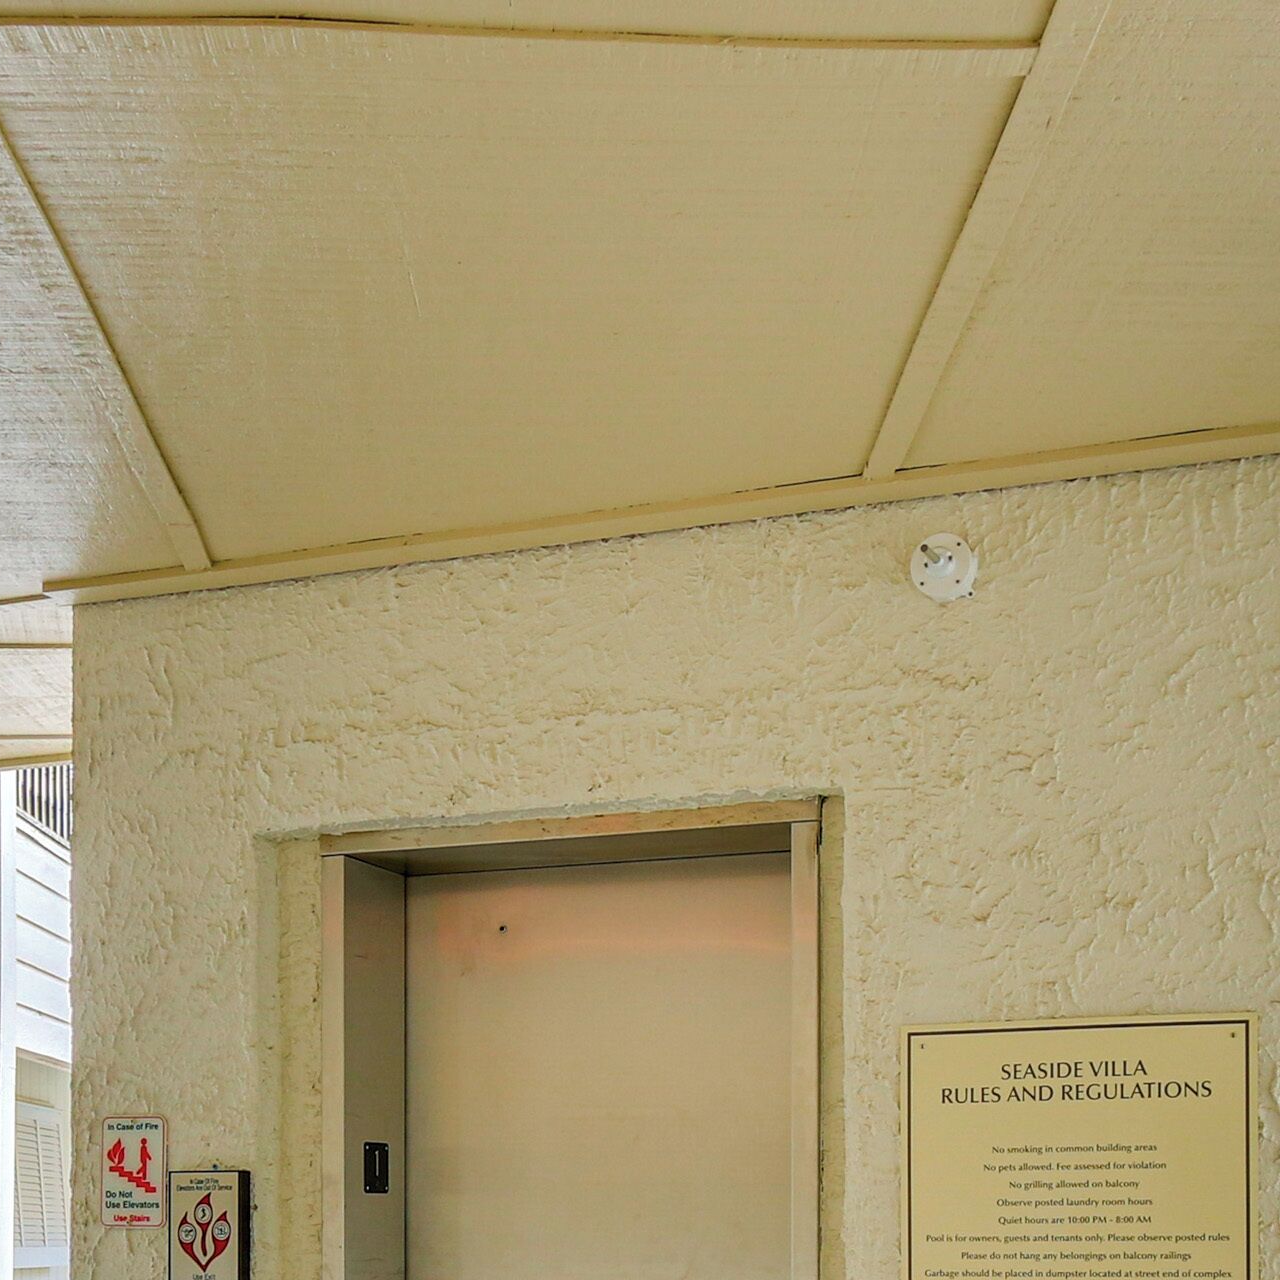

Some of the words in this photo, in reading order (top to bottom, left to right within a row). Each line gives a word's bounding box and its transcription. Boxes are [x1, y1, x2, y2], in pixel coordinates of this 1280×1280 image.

[1001, 1062, 1083, 1080] SEASIDE
[1089, 1060, 1147, 1077] VILLA
[942, 1087, 1001, 1104] RULES
[1007, 1085, 1054, 1102] AND
[1062, 1081, 1212, 1100] REGULATIONS
[992, 1146, 1005, 1154] No
[1007, 1145, 1043, 1155] smoking
[1096, 1144, 1132, 1154] building
[375, 1150, 379, 1176] 1
[998, 1164, 1016, 1173] pets
[1018, 1163, 1054, 1171] allowed.
[1074, 1162, 1111, 1170] assessed
[1128, 1161, 1167, 1169] violation
[1024, 1180, 1053, 1191] grilling
[1055, 1180, 1089, 1188] allowed
[1106, 1179, 1140, 1189] balcony
[105, 1201, 120, 1209] Use
[123, 1201, 160, 1209] Elevators
[996, 1198, 1033, 1207] Observe
[1035, 1198, 1064, 1208] posted
[1066, 1197, 1099, 1207] laundry
[1127, 1197, 1153, 1205] hours
[998, 1216, 1023, 1226] Quiet
[1025, 1216, 1049, 1224] hours
[926, 1234, 944, 1242] Pool
[1004, 1234, 1031, 1244] guests
[1085, 1233, 1105, 1243] only.
[1108, 1233, 1135, 1241] Please
[1137, 1233, 1173, 1241] observe
[1175, 1233, 1206, 1243] posted
[1208, 1233, 1230, 1241] rules
[1020, 1252, 1040, 1262] hang
[1060, 1252, 1106, 1261] belongings
[1123, 1252, 1157, 1261] balcony
[1160, 1251, 1192, 1261] railings
[924, 1269, 959, 1279] Garbage
[961, 1269, 989, 1277] should
[992, 1269, 1002, 1277] be
[1005, 1269, 1033, 1279] placed
[1046, 1269, 1087, 1279] dumpster
[1089, 1269, 1122, 1277] located
[1162, 1269, 1179, 1277] end
[1181, 1269, 1192, 1277] of
[1193, 1269, 1232, 1279] complex
